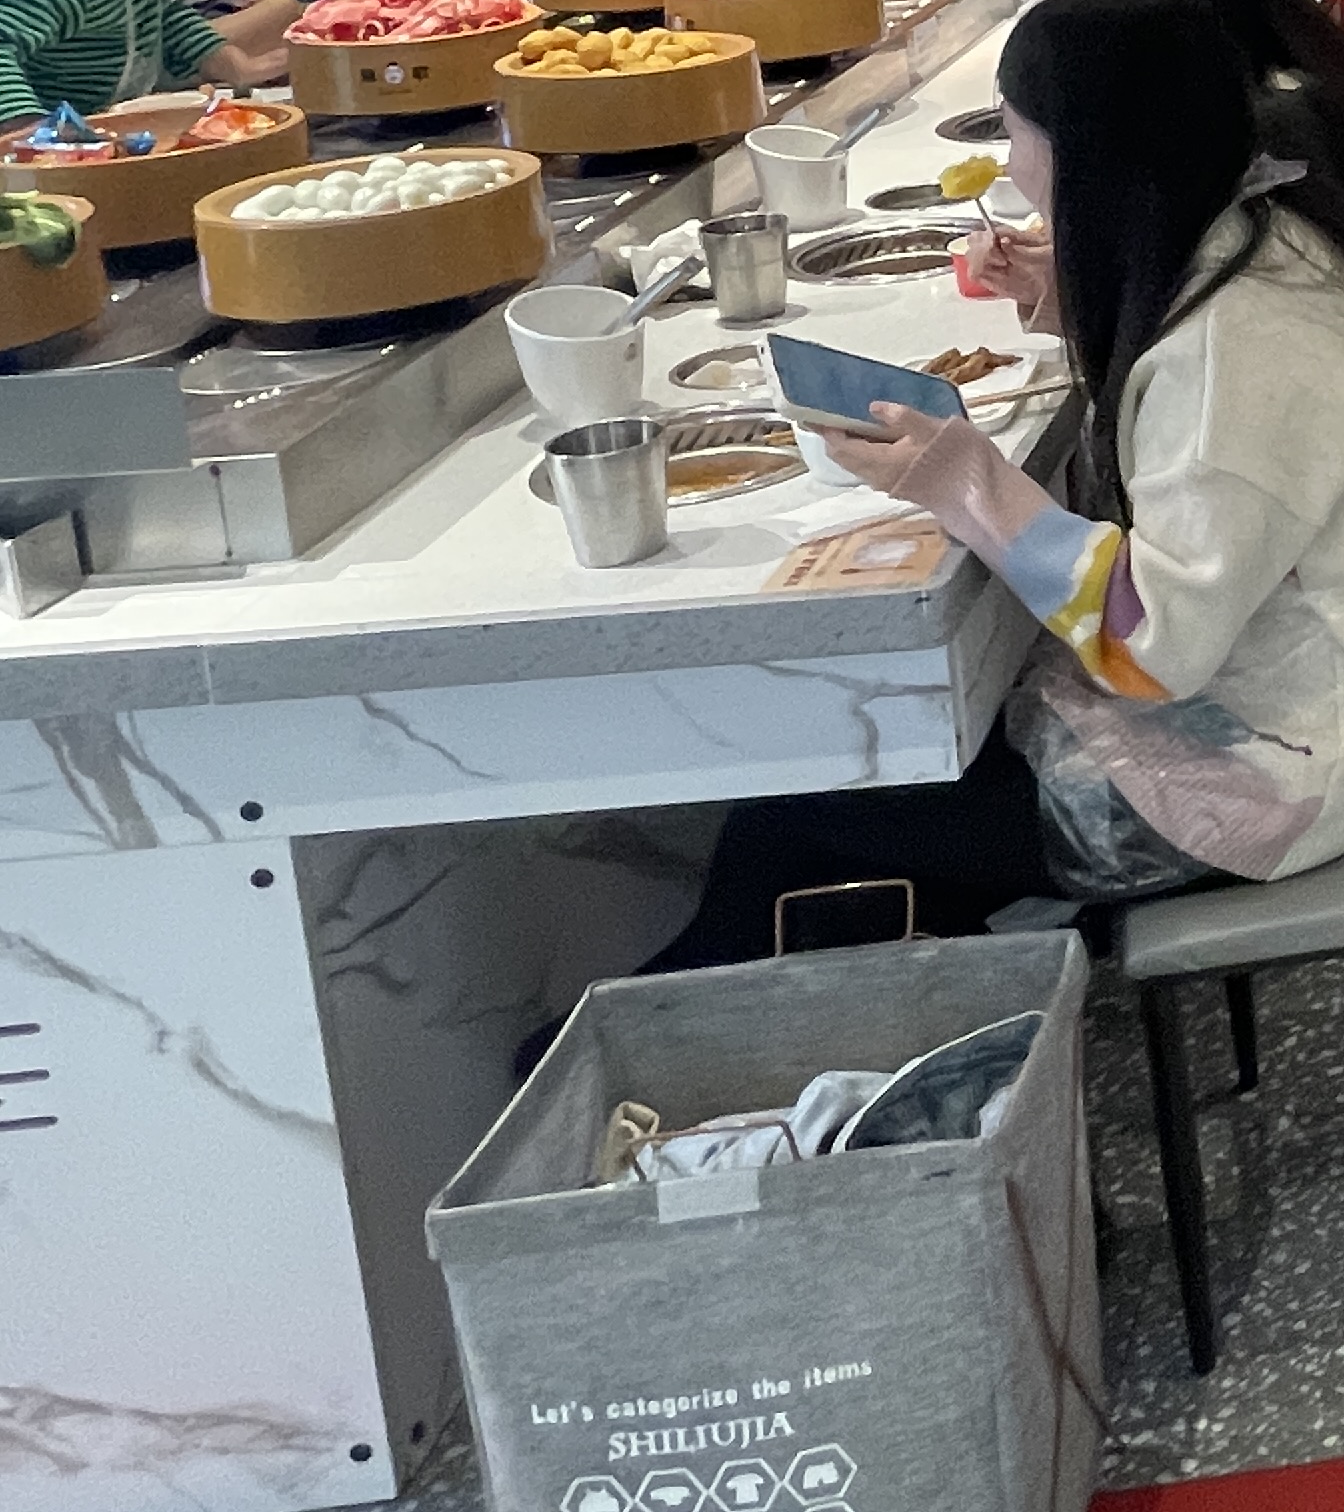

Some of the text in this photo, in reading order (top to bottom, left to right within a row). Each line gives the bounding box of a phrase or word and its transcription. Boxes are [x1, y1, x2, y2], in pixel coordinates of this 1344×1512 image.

[531, 1361, 872, 1424] Let's categorize the items
[608, 1412, 795, 1462] SHILIUJIA
